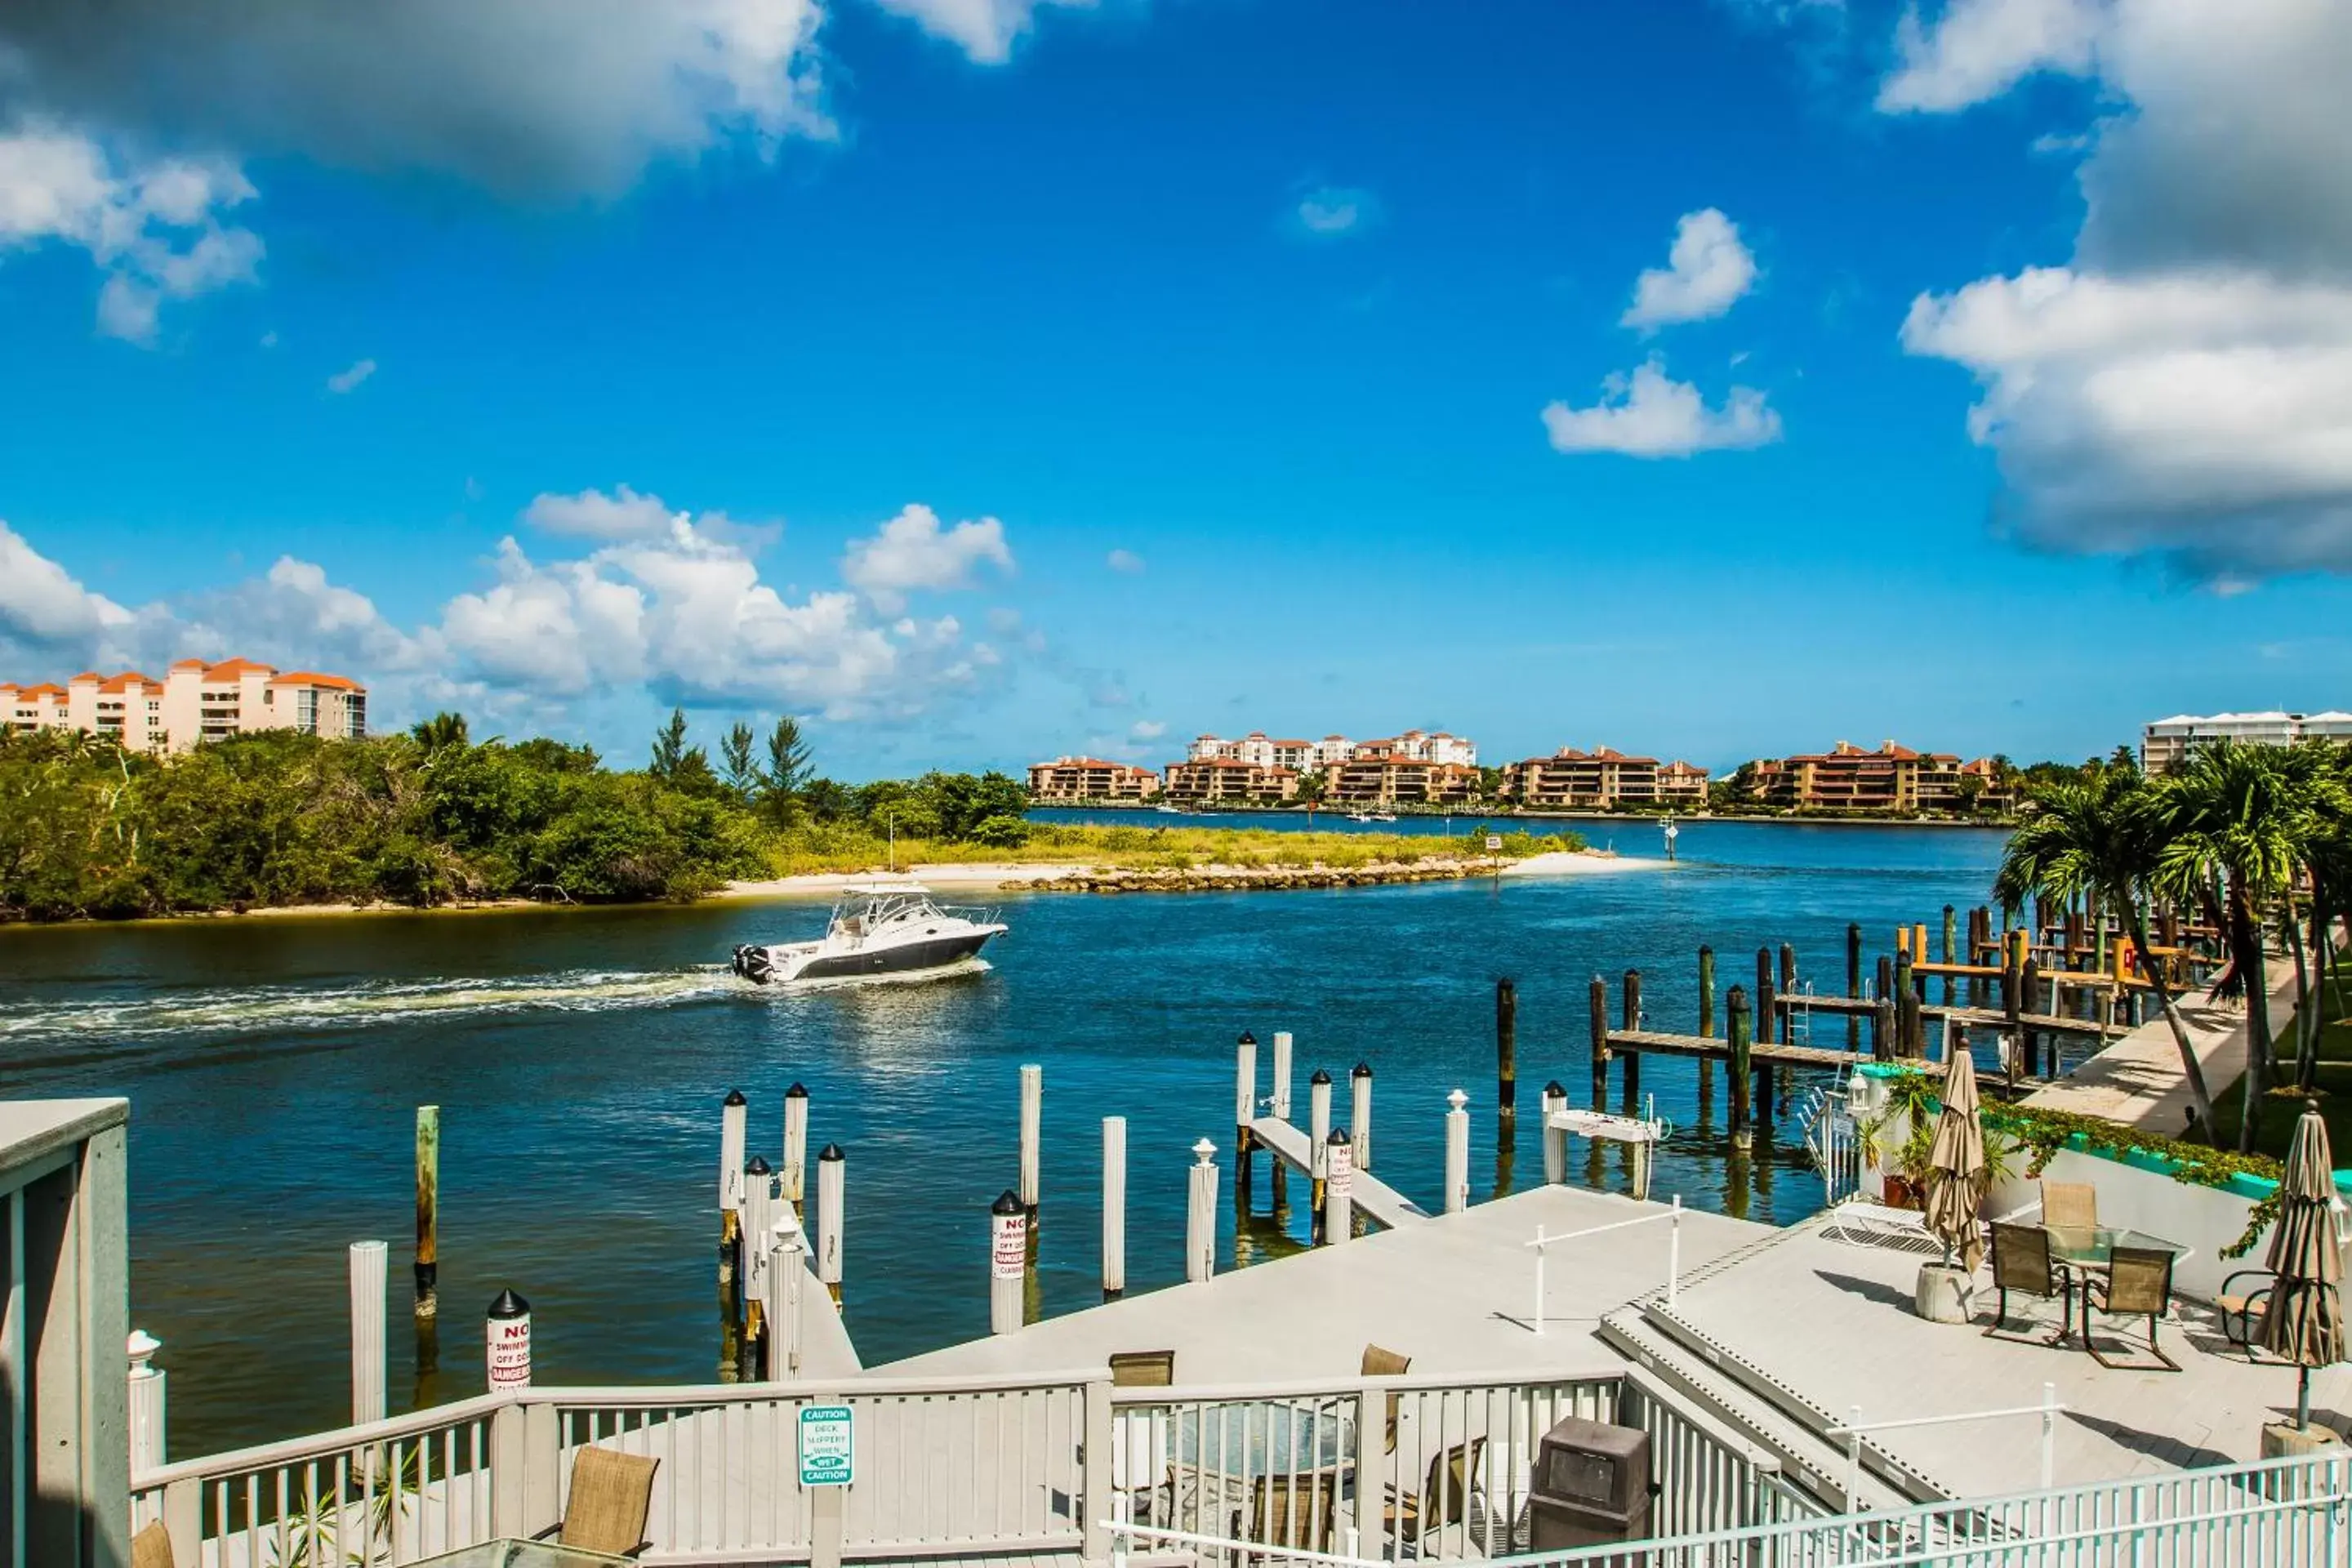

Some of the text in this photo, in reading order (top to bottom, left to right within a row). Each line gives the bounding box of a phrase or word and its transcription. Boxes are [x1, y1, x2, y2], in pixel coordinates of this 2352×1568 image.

[505, 1324, 529, 1338] NO
[497, 1356, 514, 1364] OFF
[805, 1410, 847, 1419] CAUTION
[815, 1424, 838, 1432] DECK
[807, 1436, 845, 1444] SLIPPERY
[817, 1457, 836, 1467] WET
[806, 1470, 848, 1480] CAUTION
